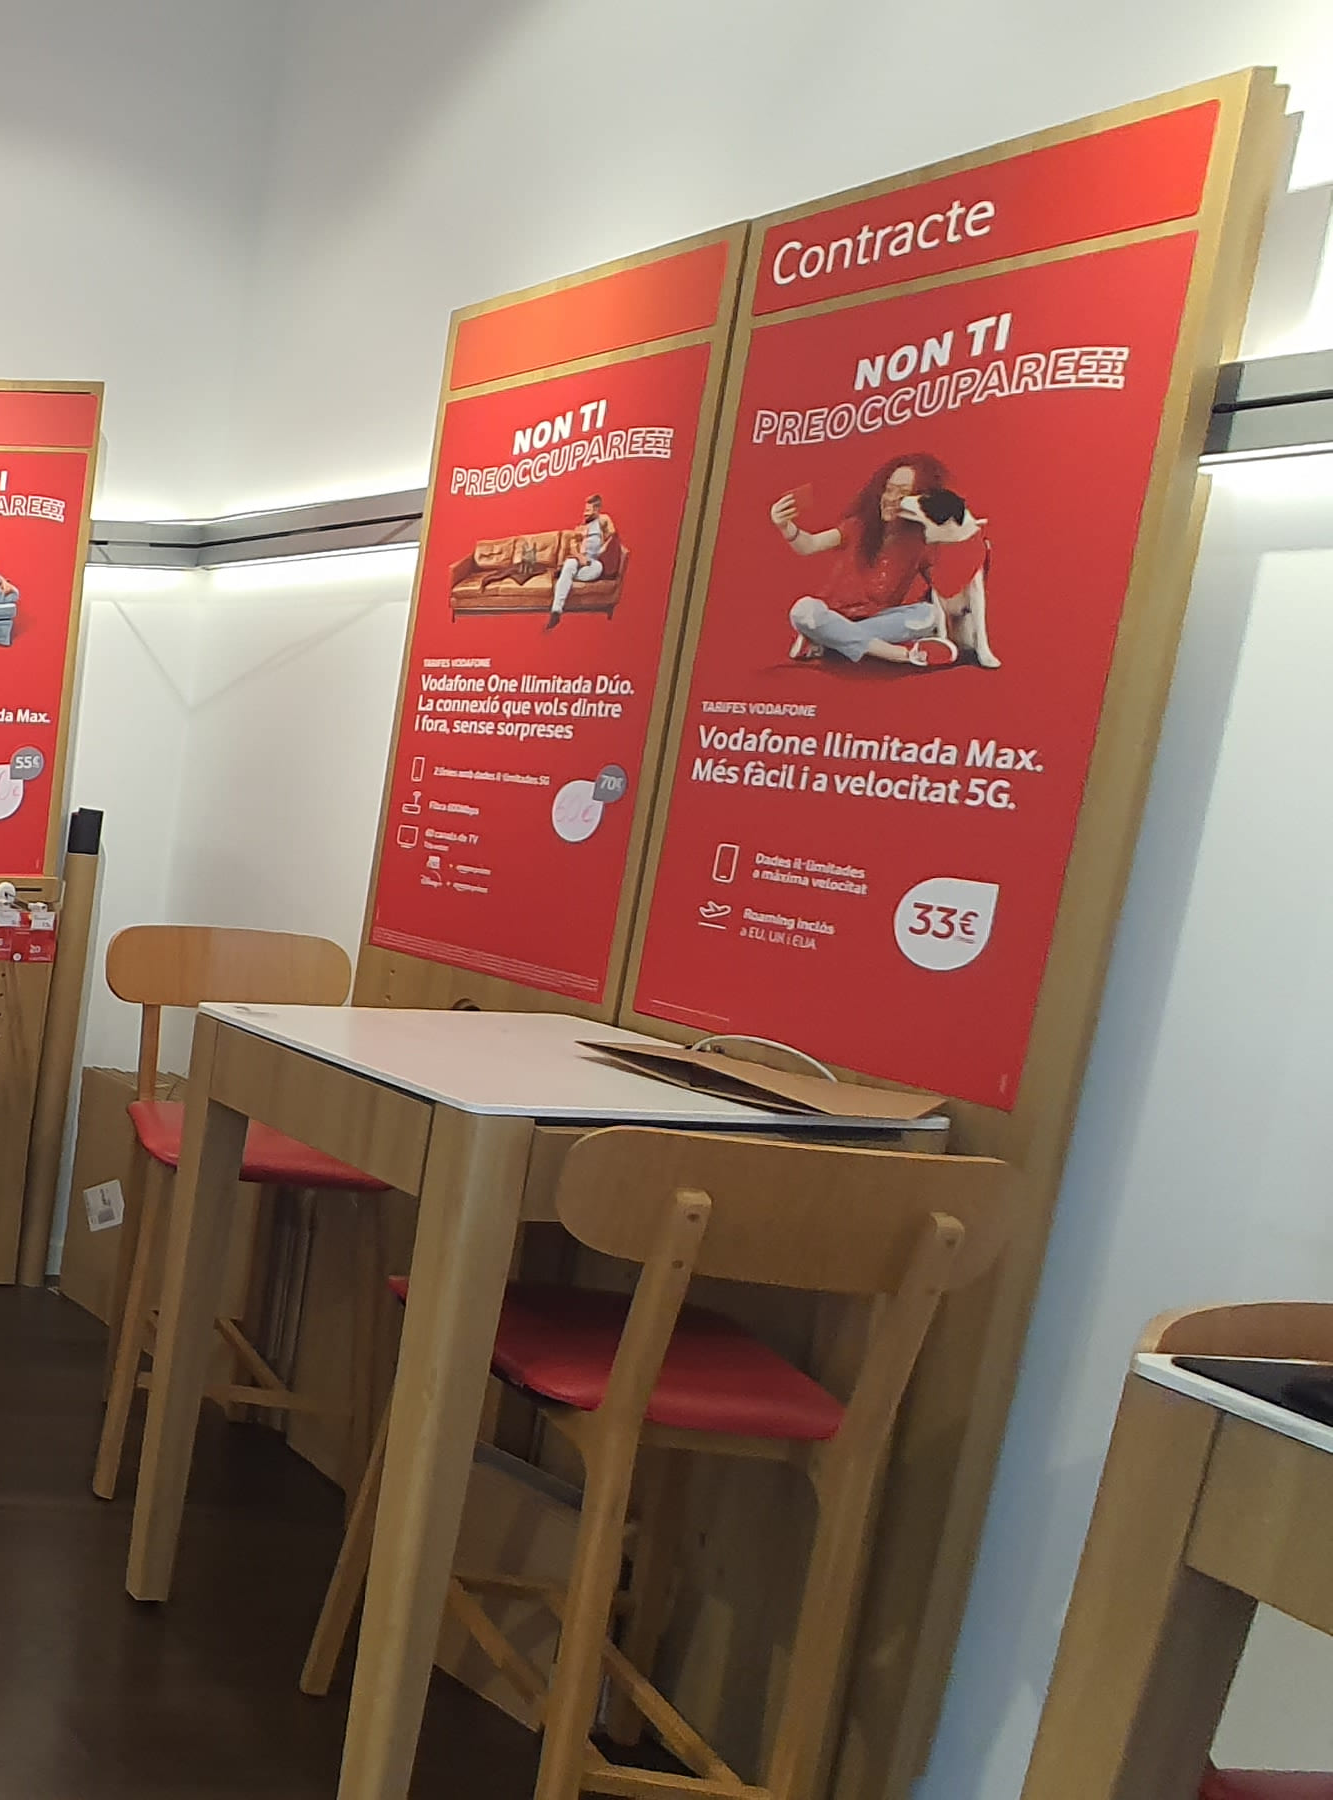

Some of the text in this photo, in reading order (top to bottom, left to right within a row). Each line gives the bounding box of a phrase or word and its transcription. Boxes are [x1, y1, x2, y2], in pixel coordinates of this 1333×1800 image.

[773, 199, 996, 286] Contracte
[853, 312, 1013, 392] NON TI
[512, 399, 607, 456] NON TI
[421, 674, 635, 696] Vodafone One Ilimitada Dúo.
[16, 709, 51, 724] Max.
[418, 695, 623, 719] La connexió que vols dintre
[749, 702, 817, 718] VODAFONE
[421, 715, 450, 735] fora,
[452, 720, 495, 735] sense
[496, 723, 574, 741] sorpreses
[698, 725, 1044, 773] Vodafone Ilimitada Max.
[691, 757, 1017, 810] Més fàcil i a velocitat 5G.
[755, 852, 792, 868] Dades
[812, 877, 868, 895] velocitat
[743, 907, 796, 930] Roaming
[907, 901, 981, 941] 33€
